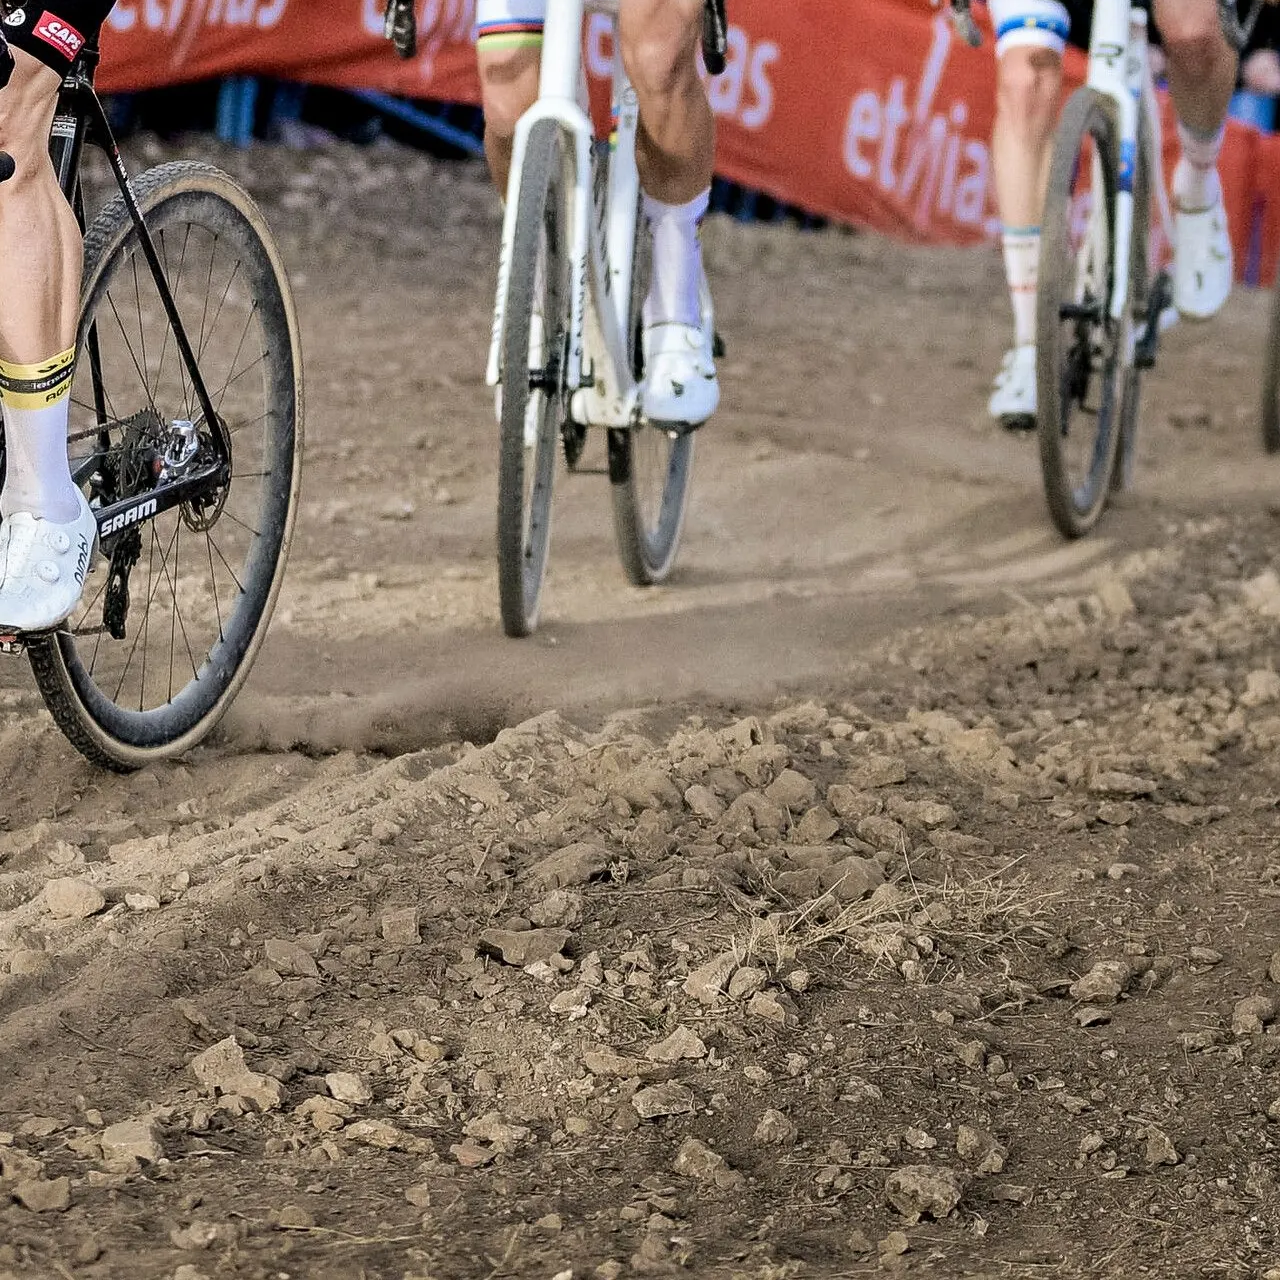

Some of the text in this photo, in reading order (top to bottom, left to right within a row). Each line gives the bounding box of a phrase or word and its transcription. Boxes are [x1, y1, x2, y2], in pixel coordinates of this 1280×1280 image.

[48, 21, 81, 50] CAPS
[842, 18, 1004, 233] ethia
[100, 497, 157, 538] SRAM
